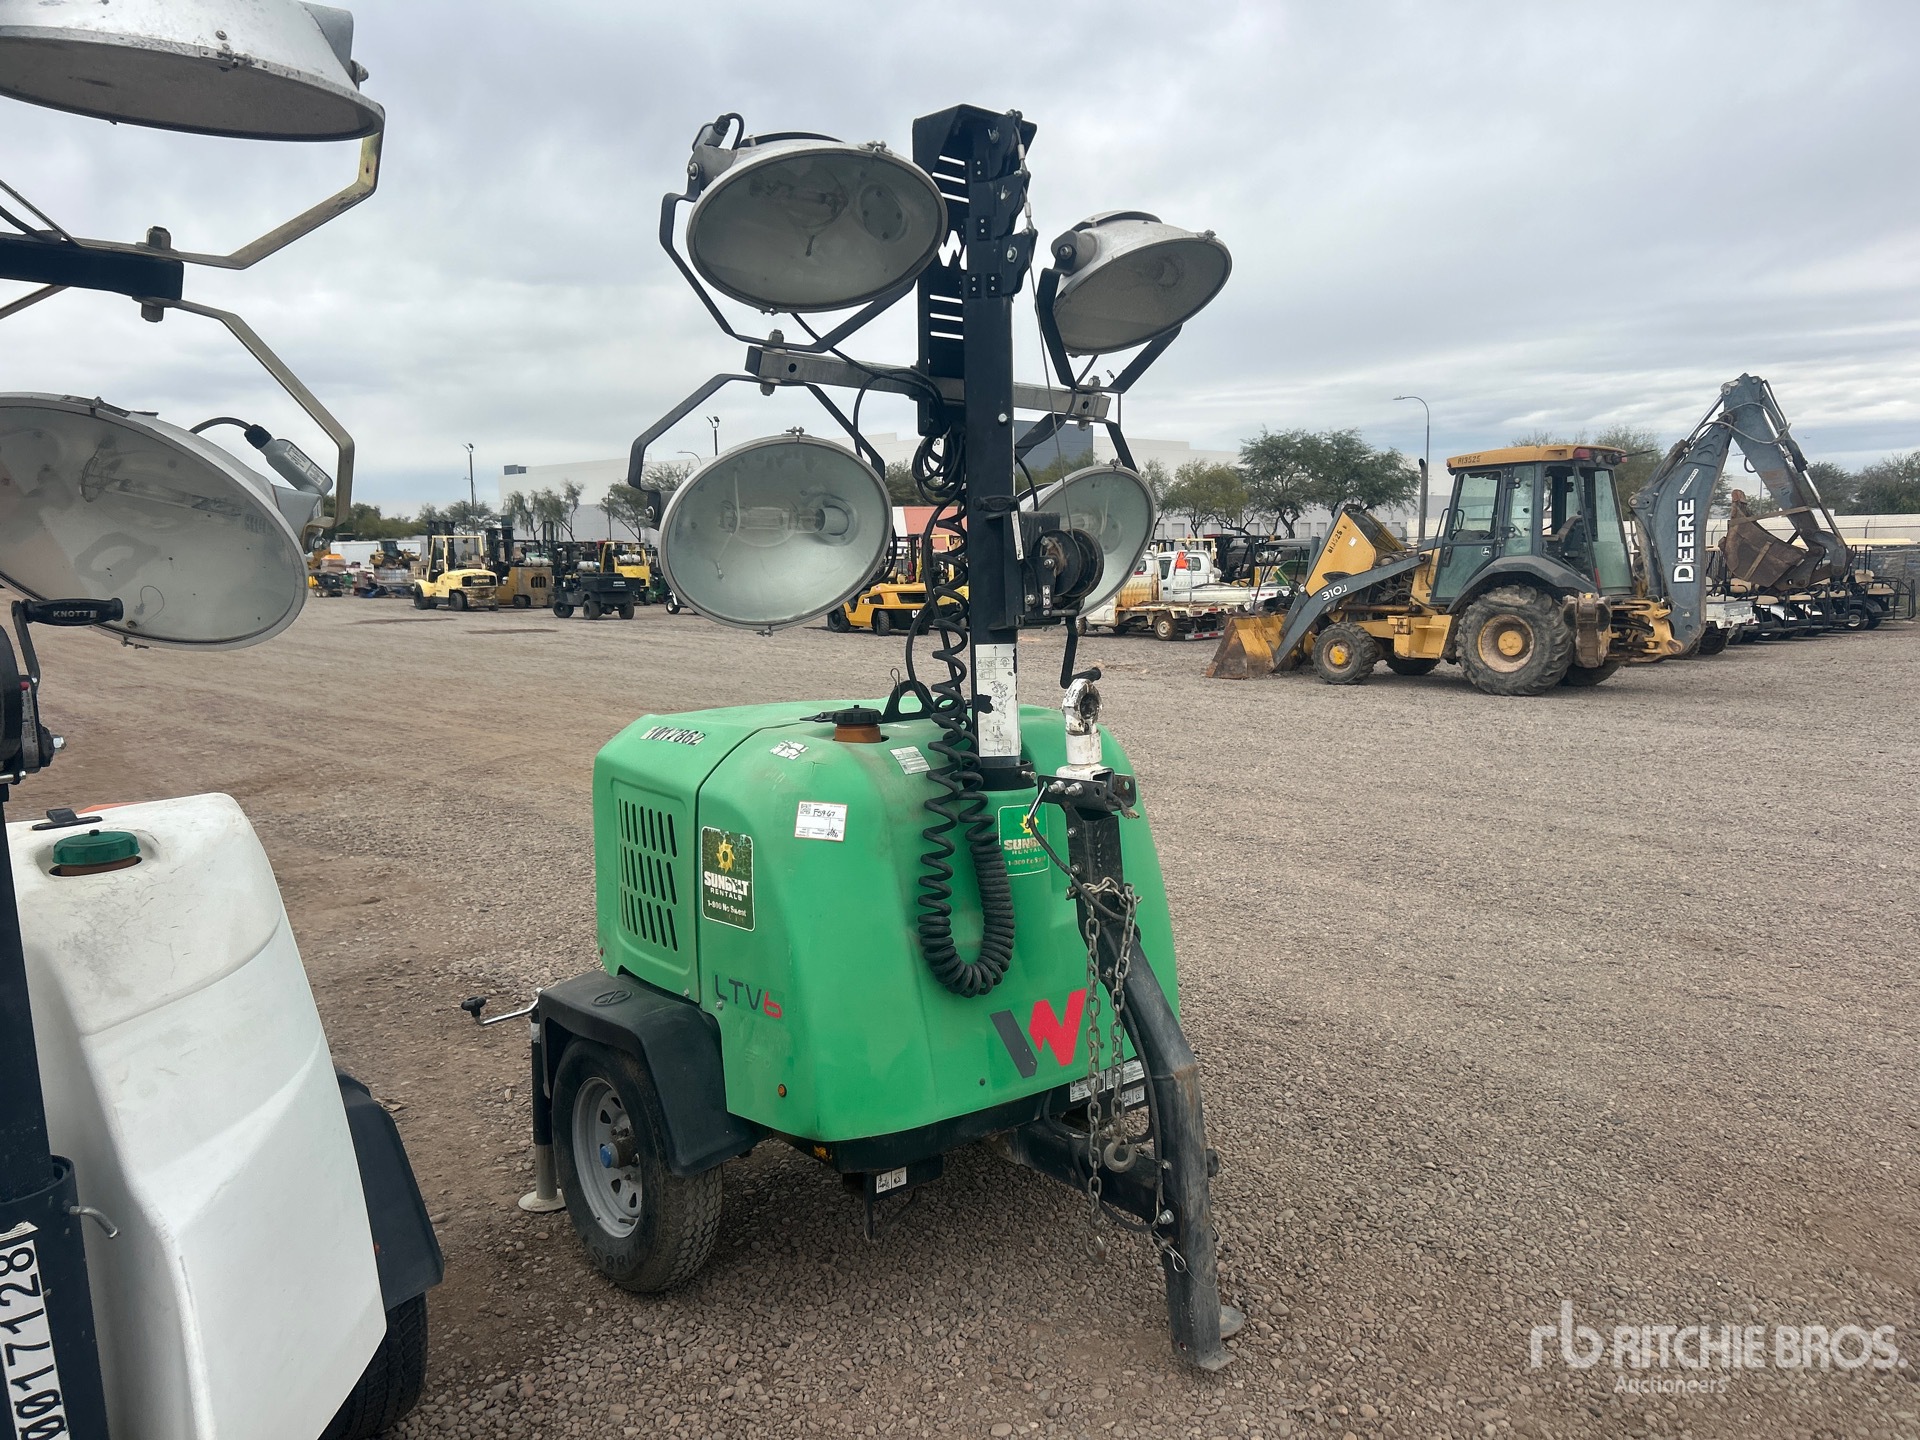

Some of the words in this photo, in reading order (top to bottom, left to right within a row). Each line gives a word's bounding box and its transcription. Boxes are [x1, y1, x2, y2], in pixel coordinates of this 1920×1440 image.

[1673, 499, 1695, 583] DEERE
[1321, 584, 1348, 601] 310J
[53, 610, 88, 618] KNOTT
[710, 887, 743, 902] RENTALS
[714, 974, 783, 1019] LTV6
